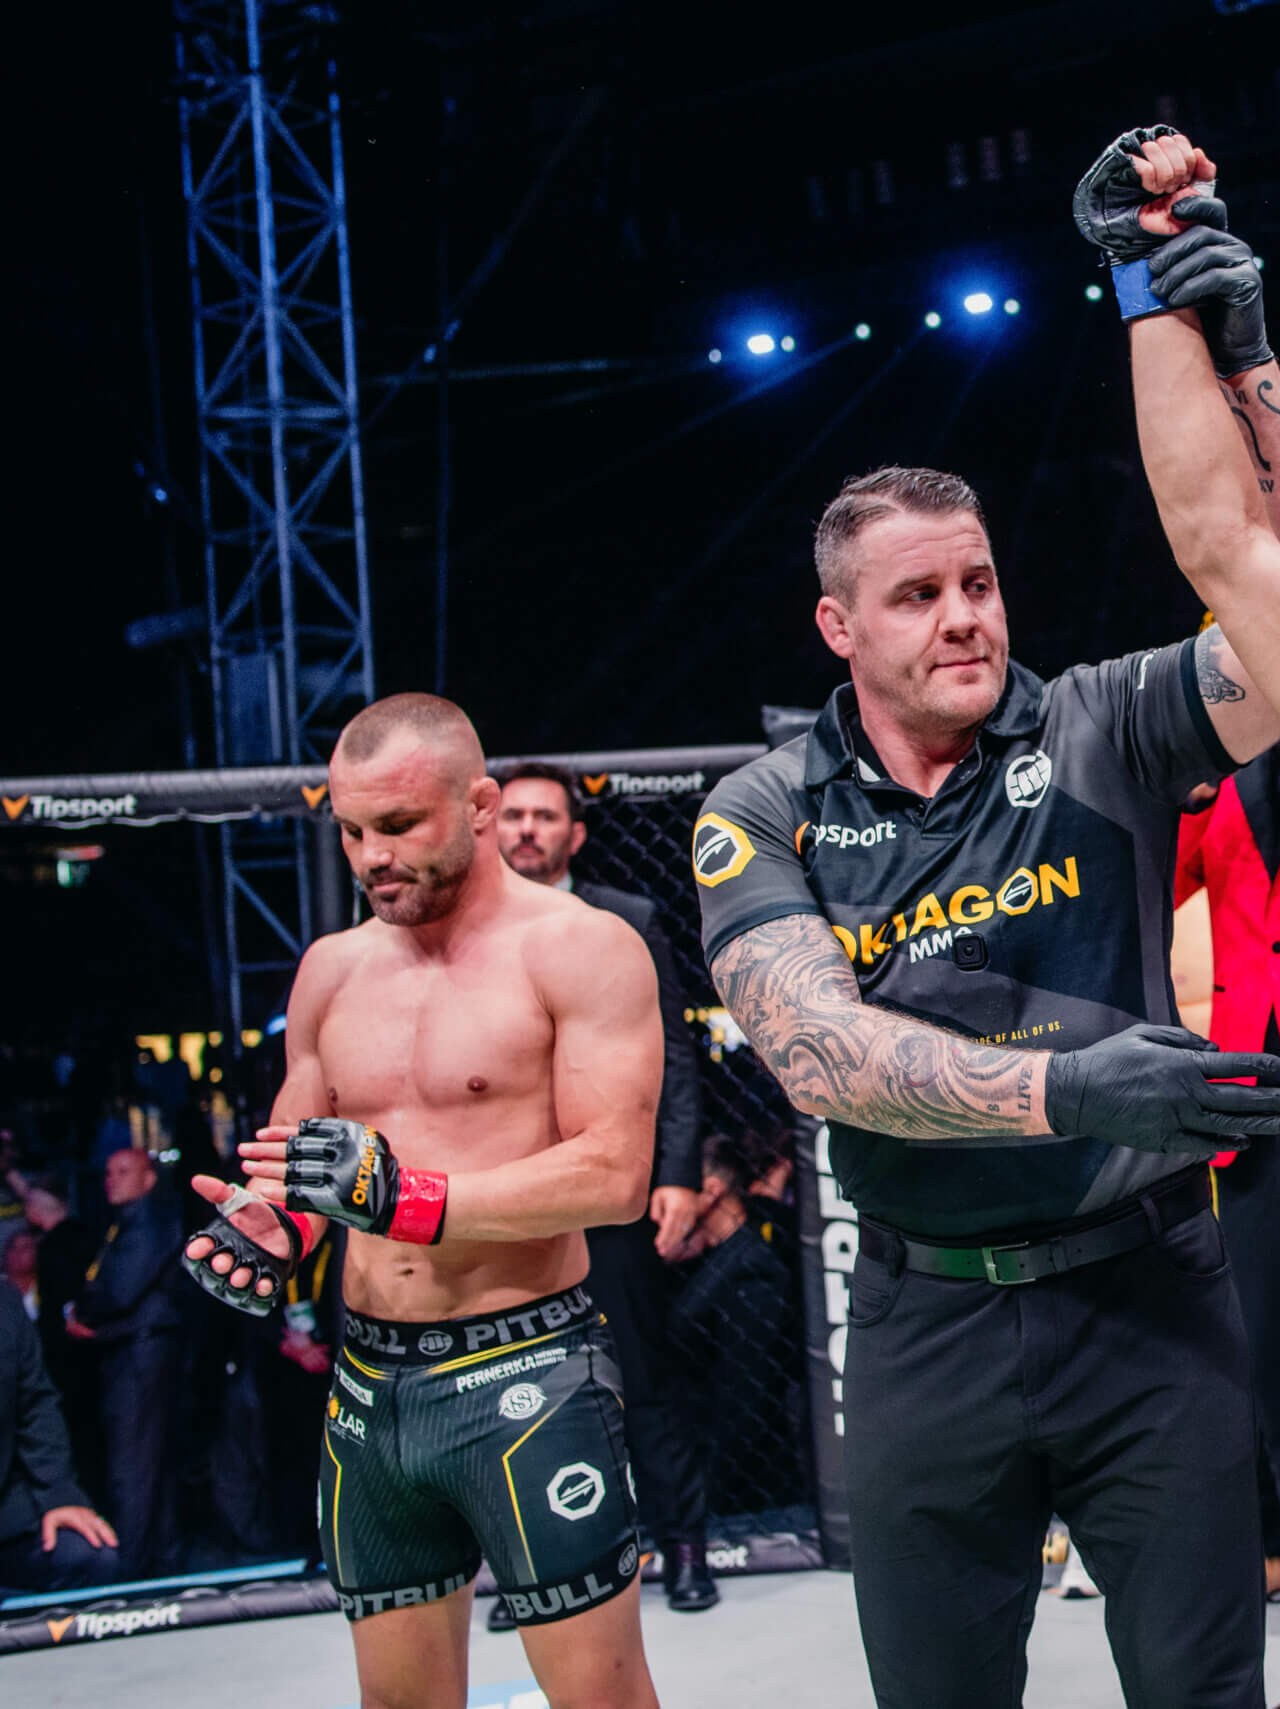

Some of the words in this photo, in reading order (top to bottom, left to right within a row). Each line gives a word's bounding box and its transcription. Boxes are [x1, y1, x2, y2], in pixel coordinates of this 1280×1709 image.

[610, 771, 705, 794] Tipsport
[30, 793, 138, 819] Tipsport
[1011, 1028, 1029, 1041] ALL
[1032, 1024, 1044, 1037] OF
[456, 1356, 537, 1393] PERNERKA
[76, 1604, 182, 1639] Tipsport
